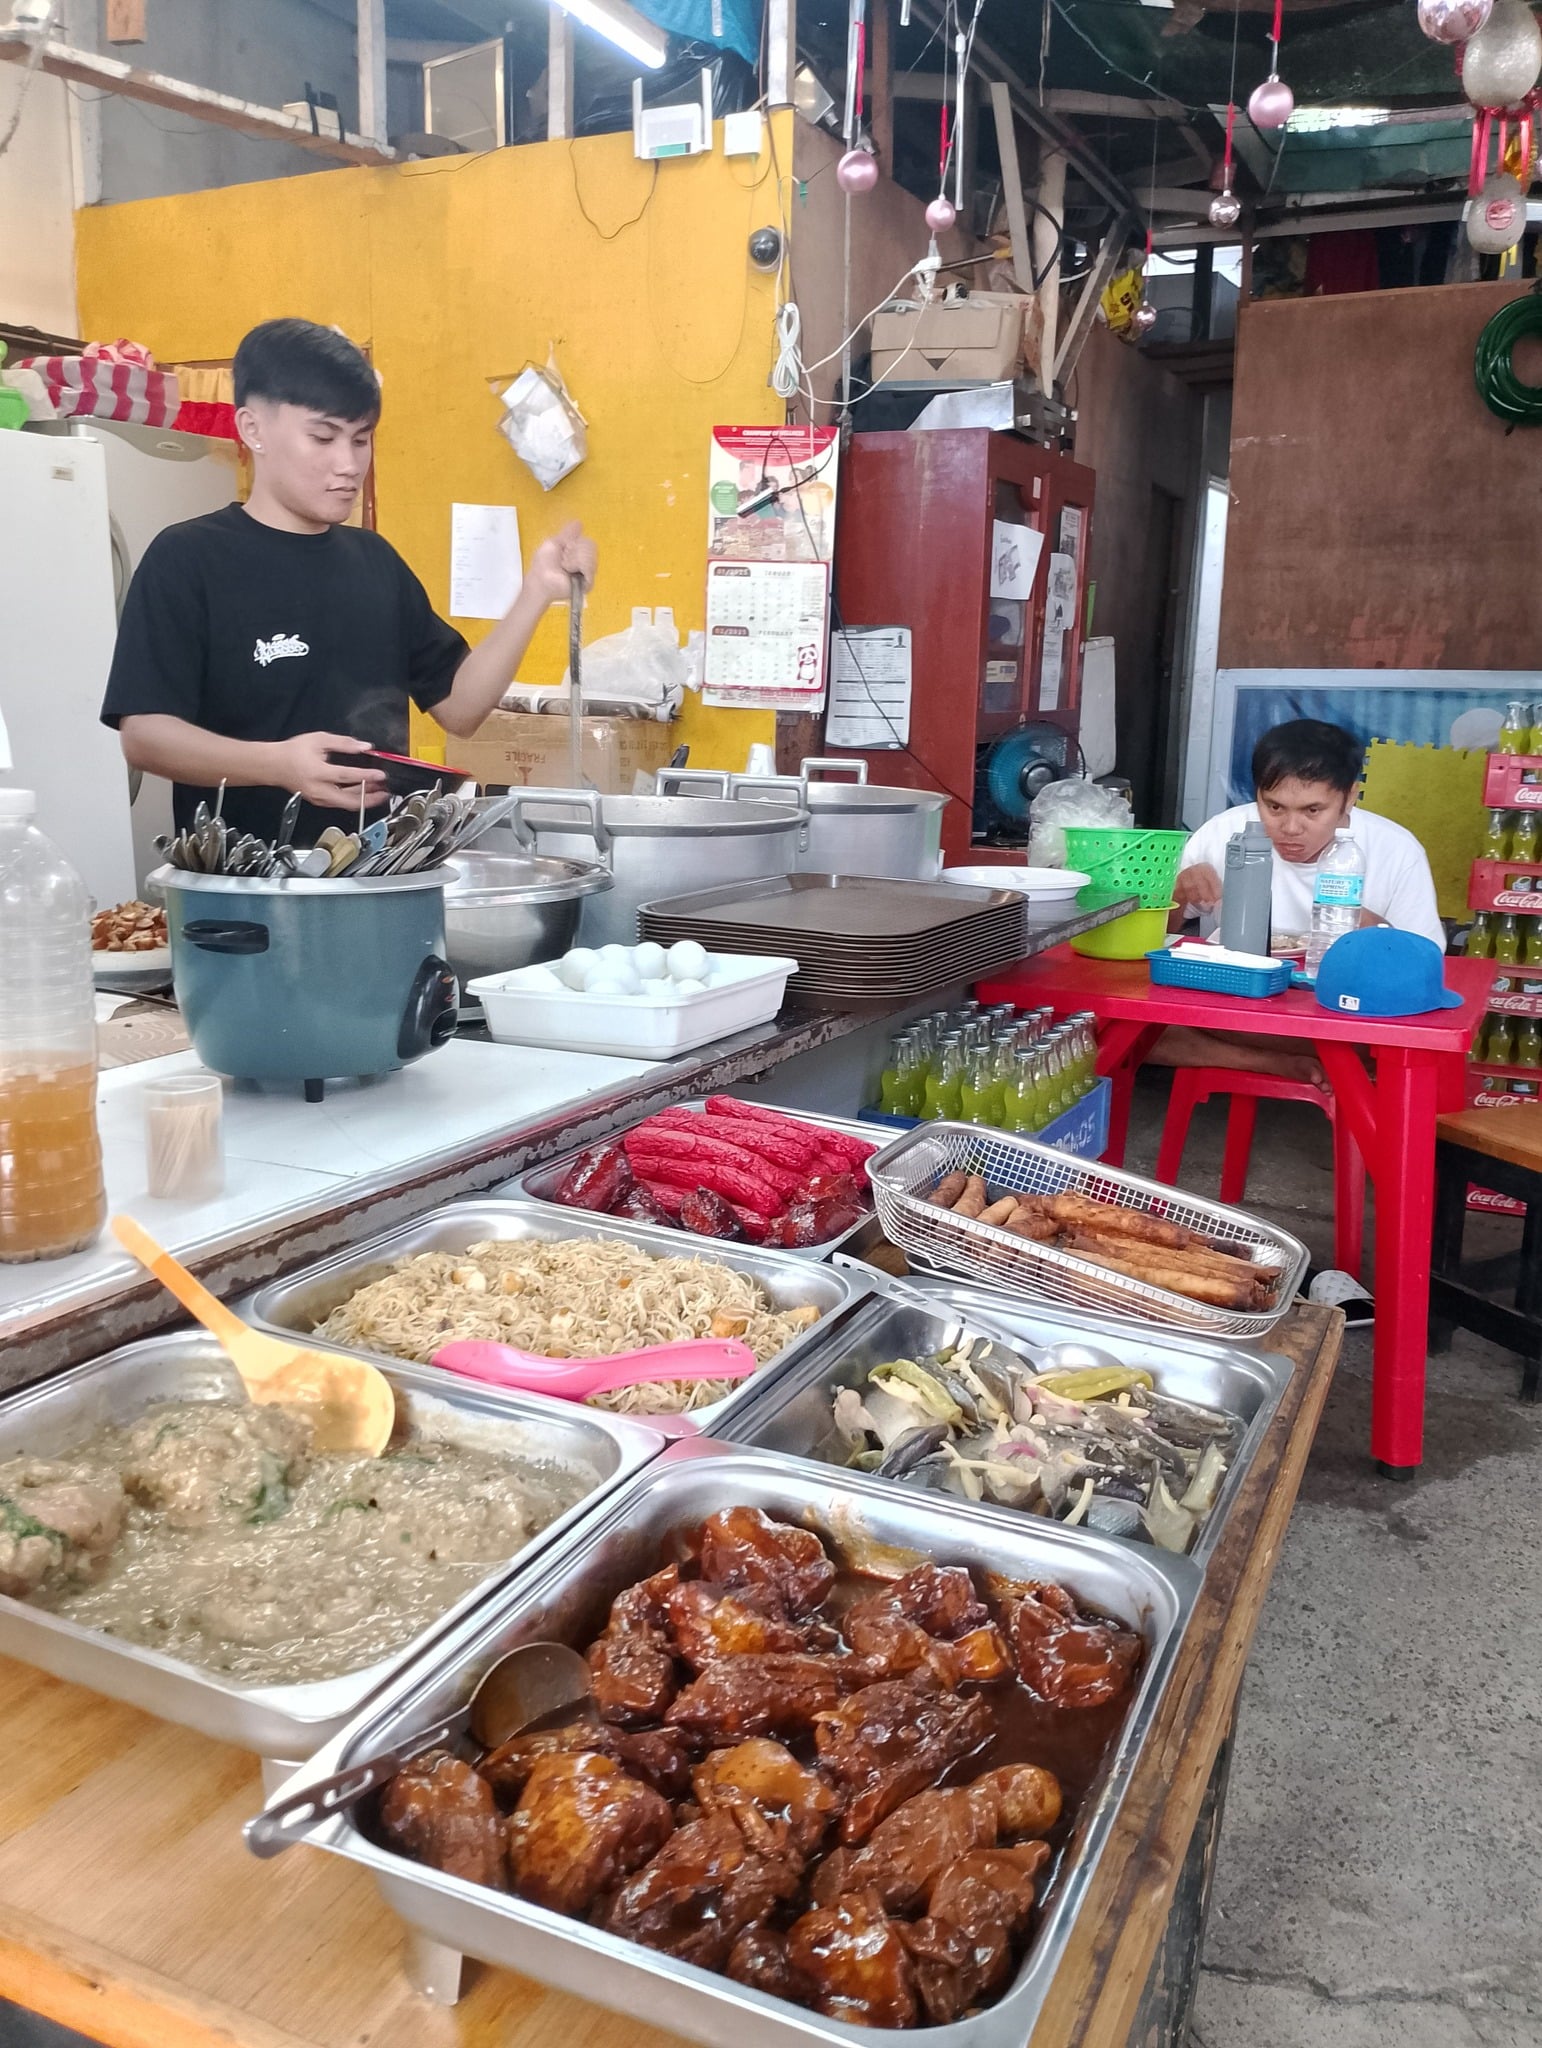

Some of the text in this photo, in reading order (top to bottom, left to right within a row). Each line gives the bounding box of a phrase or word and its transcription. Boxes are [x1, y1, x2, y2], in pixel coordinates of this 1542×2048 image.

[504, 751, 546, 764] FRAGILE
[1493, 891, 1542, 908] Coca-Col
[1467, 1191, 1517, 1208] Coca-Cola
